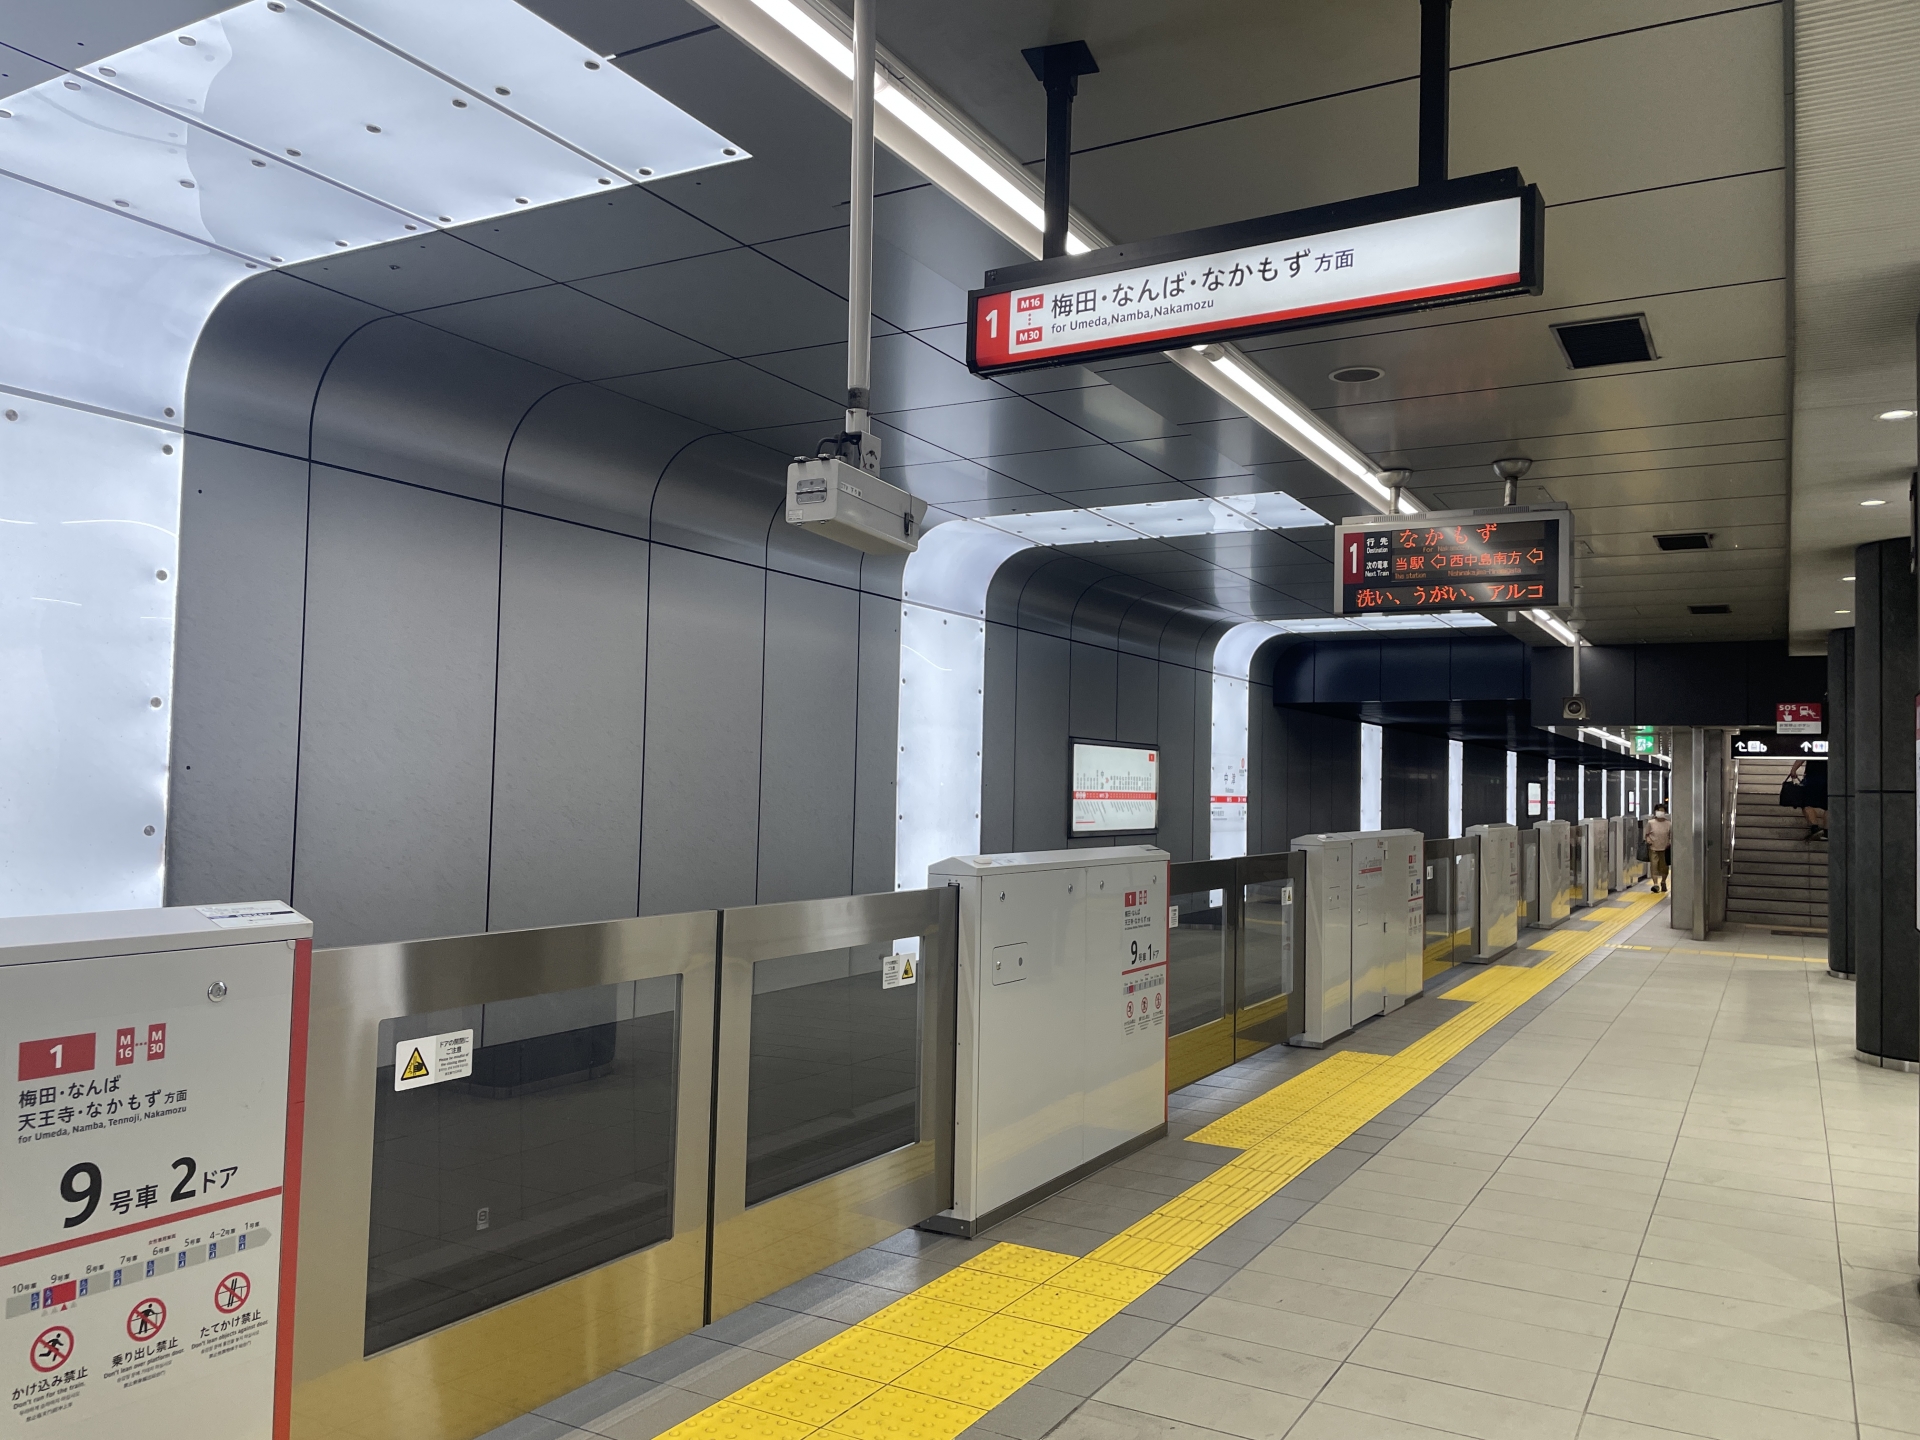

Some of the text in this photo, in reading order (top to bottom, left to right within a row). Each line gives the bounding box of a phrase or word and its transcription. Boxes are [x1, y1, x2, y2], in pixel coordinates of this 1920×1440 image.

[1020, 297, 1040, 309] M16
[985, 310, 998, 338] 1
[1051, 324, 1066, 334] for
[1019, 330, 1039, 342] M30
[1399, 523, 1498, 548] なかもず
[1349, 542, 1358, 574] 1
[1395, 551, 1523, 571] 当駅 西中島南方
[1366, 560, 1389, 570] 次の電車
[1405, 571, 1427, 579] station
[120, 1035, 131, 1046] M
[151, 1030, 162, 1041] M
[118, 1048, 133, 1059] 16
[149, 1043, 164, 1054] 30
[49, 1044, 63, 1069] 1
[18, 1074, 121, 1109] 梅田・なんば
[17, 1106, 187, 1144] for Umeda, Namba, Tennoji, Nakamozu
[200, 1308, 262, 1339] たてかけ禁止
[191, 1340, 206, 1350] Don't
[111, 1336, 179, 1369] 乗り出し禁止
[103, 1369, 120, 1379] Don't
[11, 1366, 88, 1401] かけ込み禁止
[13, 1398, 32, 1410] Don't
